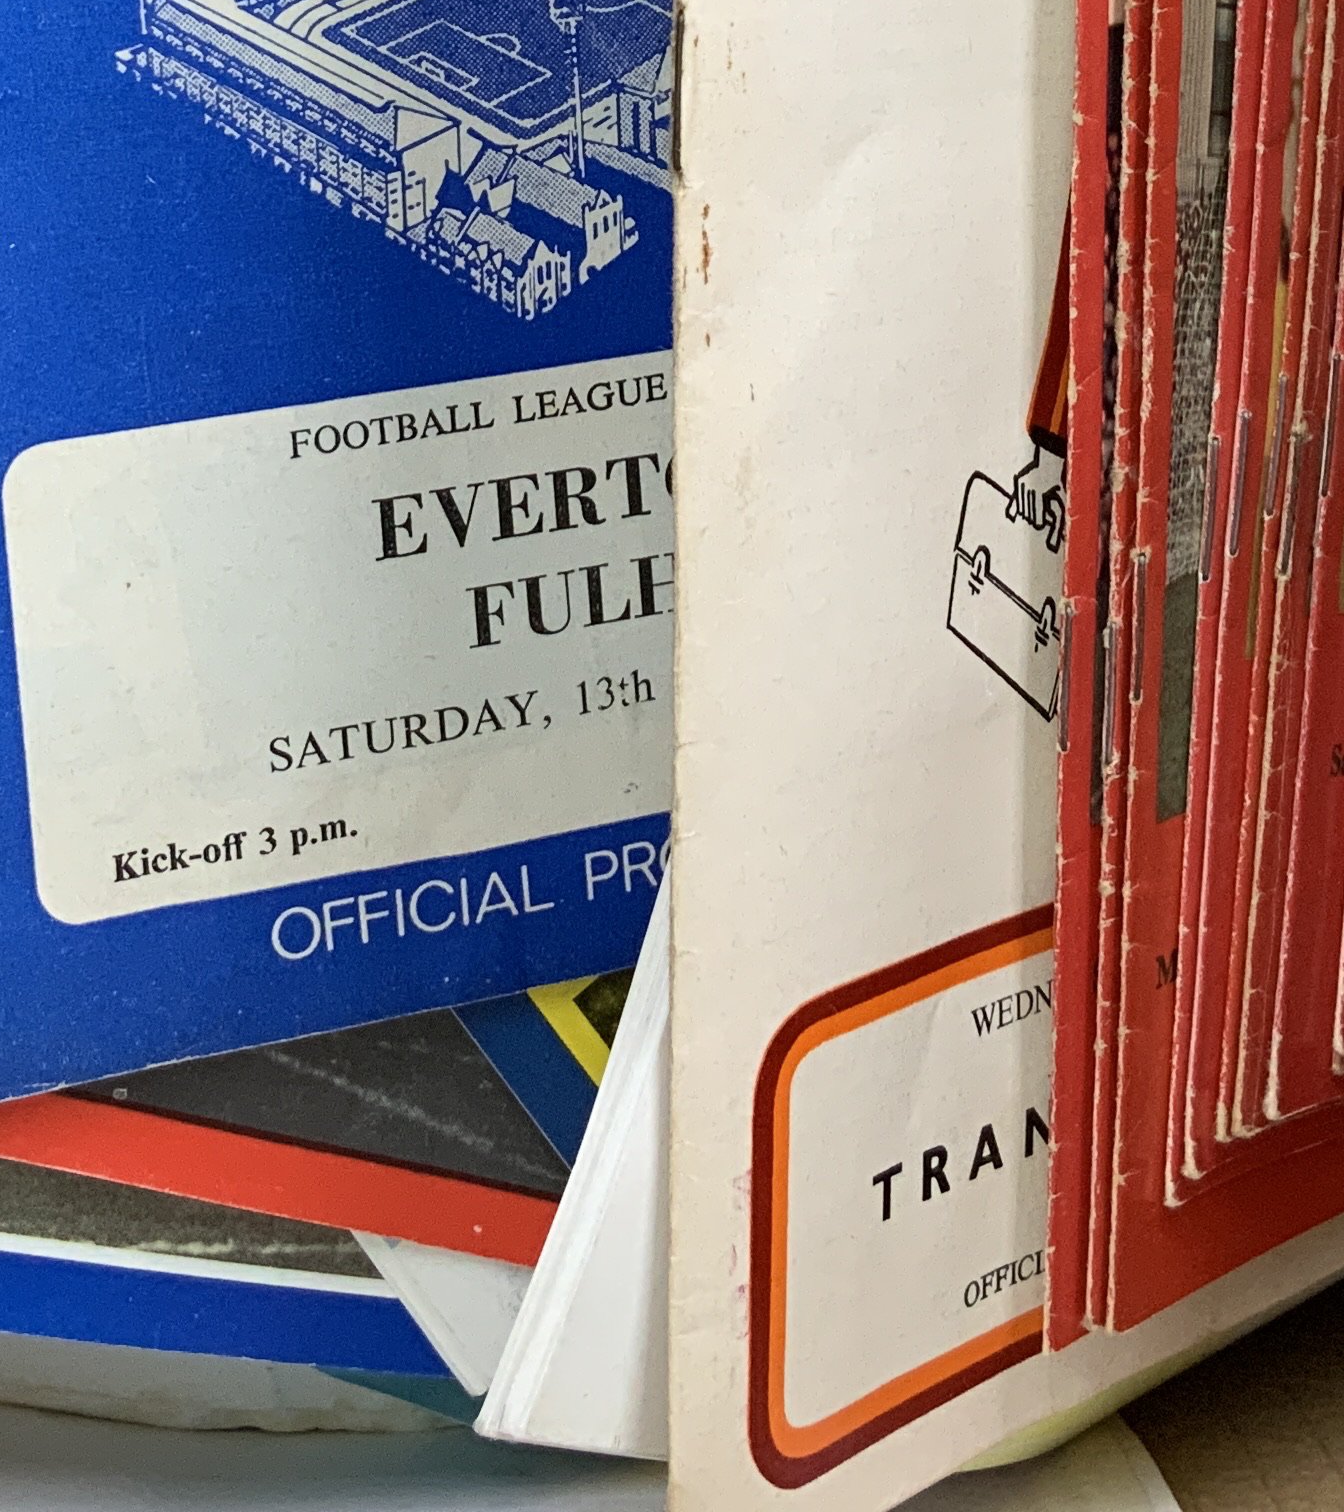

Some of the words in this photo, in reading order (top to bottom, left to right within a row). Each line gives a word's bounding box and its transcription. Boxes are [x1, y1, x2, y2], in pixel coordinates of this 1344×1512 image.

[289, 400, 496, 460] FOOTBALL
[512, 373, 668, 423] LEAGUE
[372, 452, 677, 562] EVERT
[269, 691, 552, 774] SATURDAY,
[577, 670, 655, 715] 13th
[113, 832, 247, 884] Kick-off
[259, 827, 277, 856] 3
[291, 813, 358, 856] p.m.
[271, 865, 554, 961] OFFICIAL
